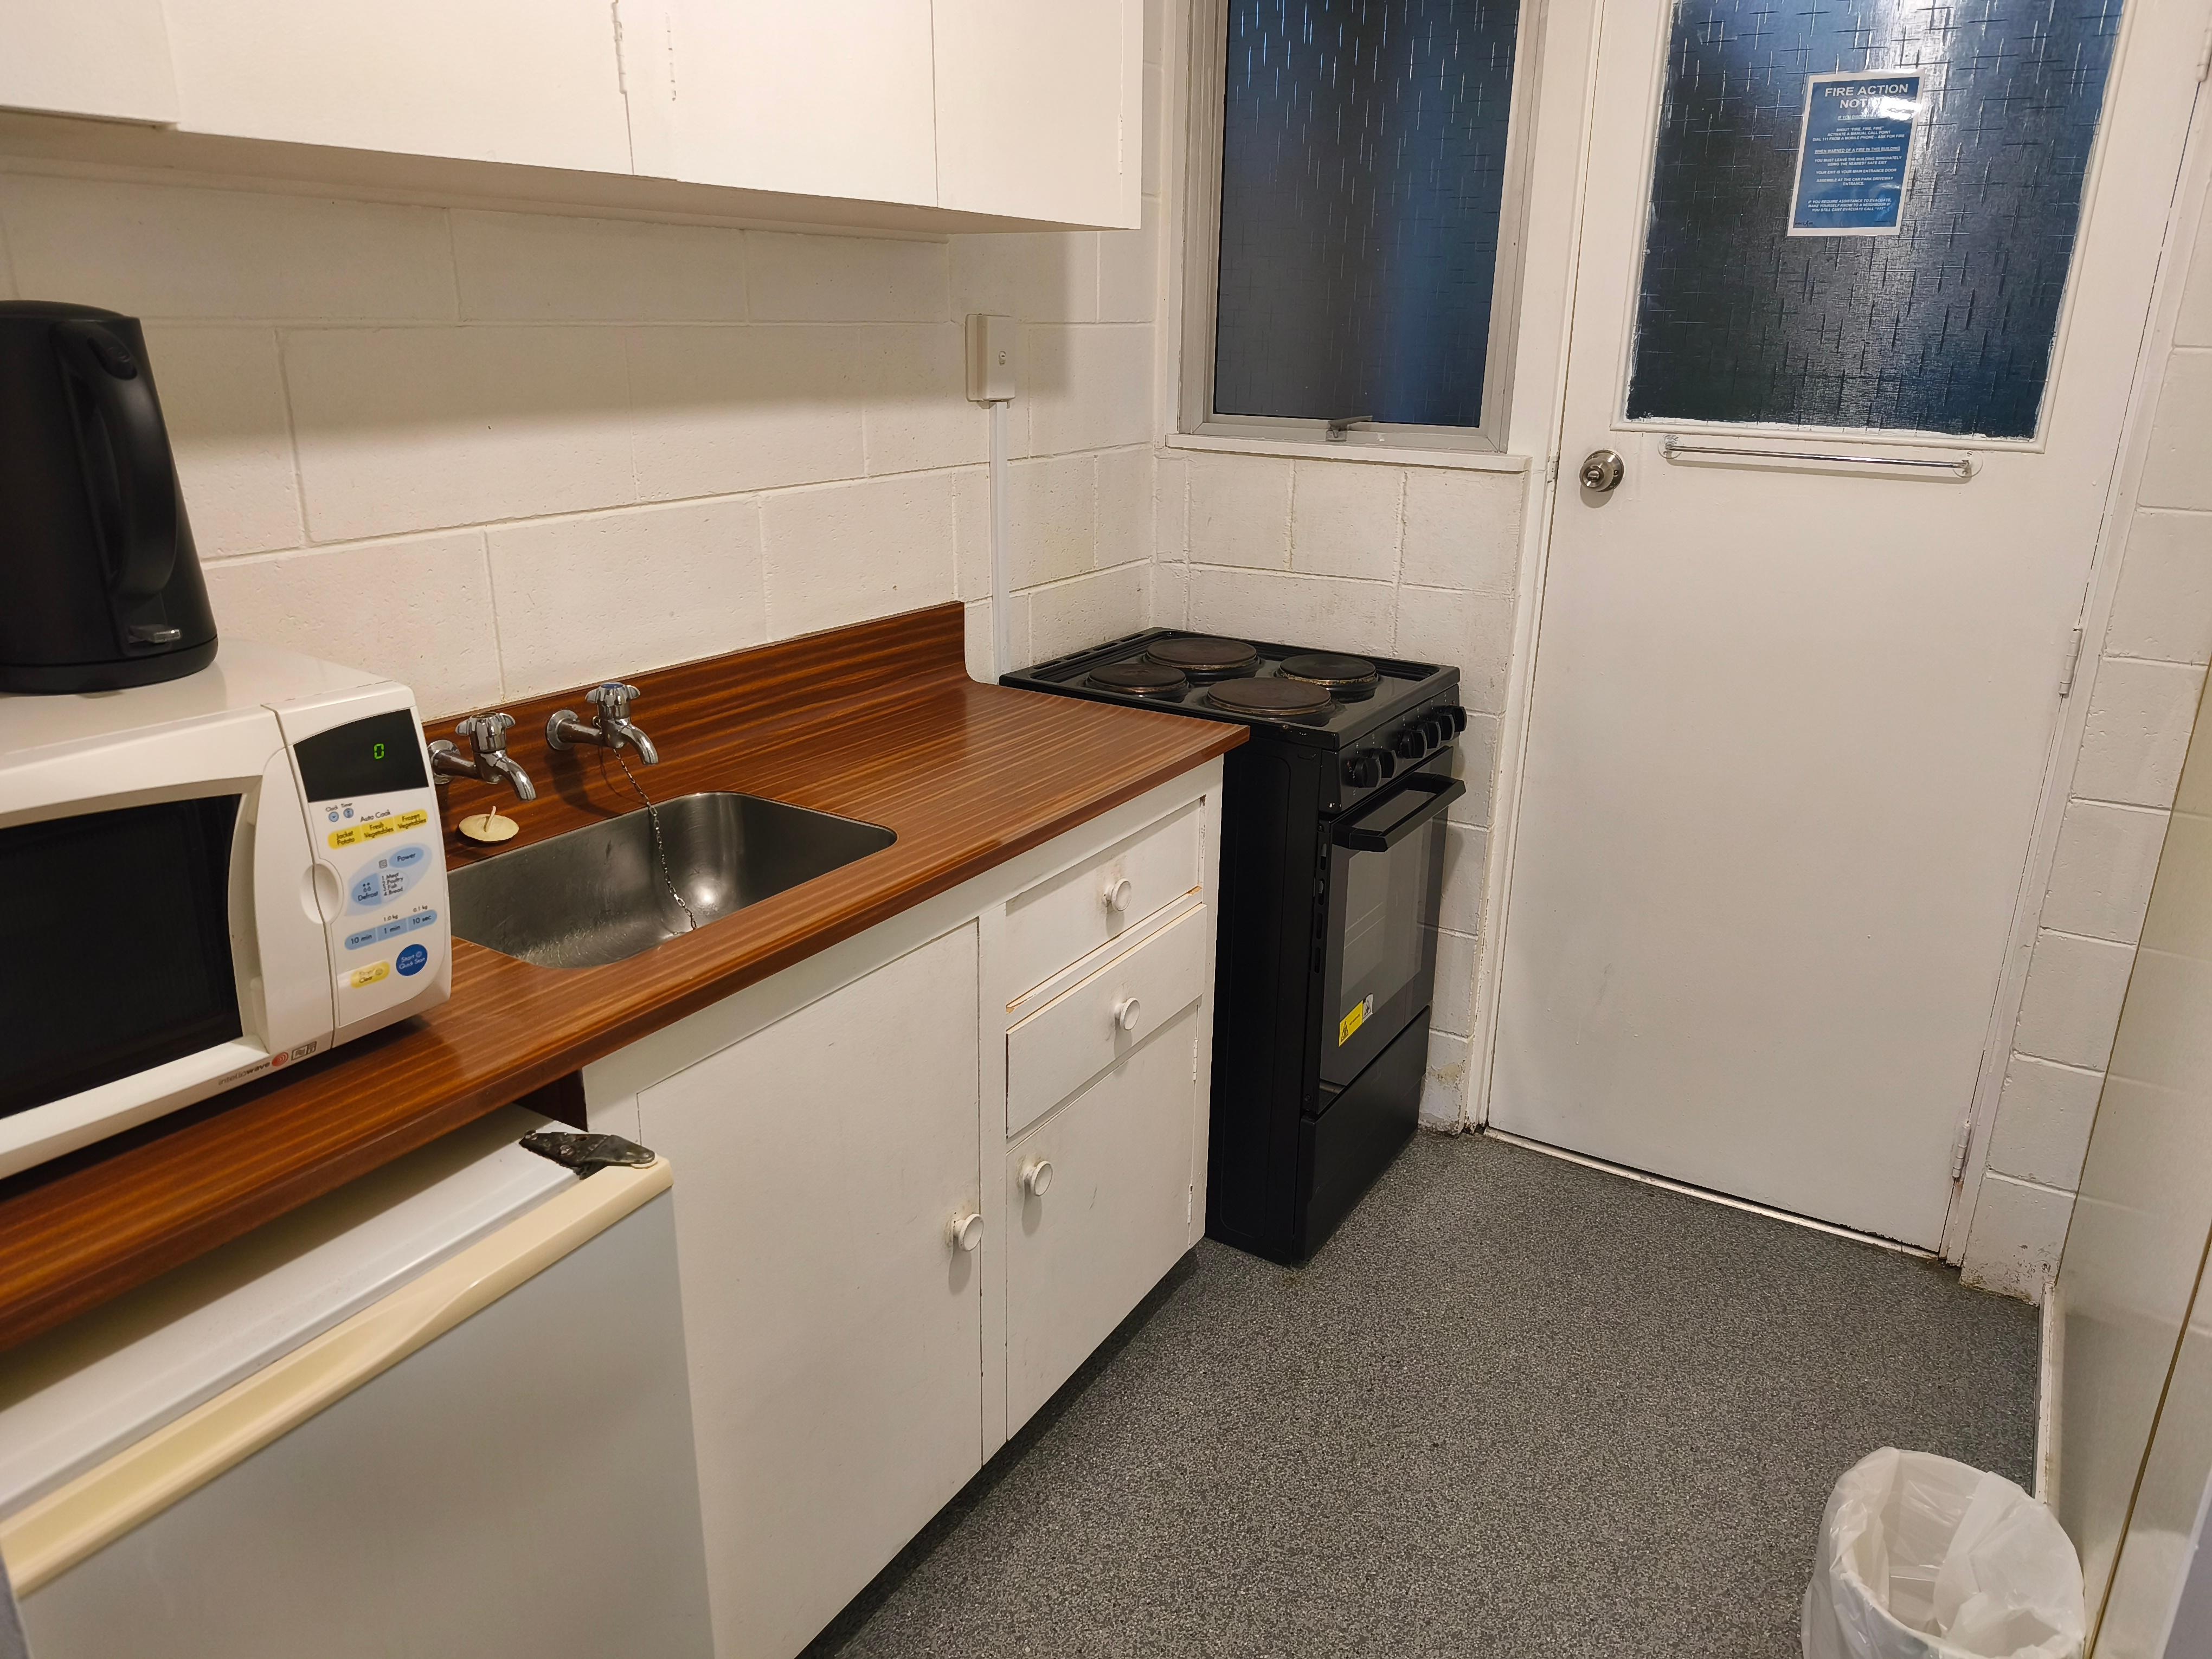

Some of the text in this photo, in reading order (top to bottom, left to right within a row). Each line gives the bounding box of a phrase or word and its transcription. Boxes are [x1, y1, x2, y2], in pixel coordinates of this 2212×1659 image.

[1825, 83, 1908, 97] FIRE ACTION
[1840, 97, 1883, 108] NOT
[374, 743, 384, 760] 0
[360, 809, 391, 823] Auto Cook
[402, 813, 420, 822] Frozen
[369, 822, 384, 831] Fresh
[397, 818, 427, 830] Vegetables
[336, 831, 353, 840] Jacket
[364, 827, 394, 839] Vegetables
[337, 837, 355, 846] Potato
[397, 853, 416, 862] Power
[358, 891, 378, 902] Defrost
[413, 917, 421, 925] 10
[351, 937, 359, 945] 10
[401, 954, 415, 963] Start
